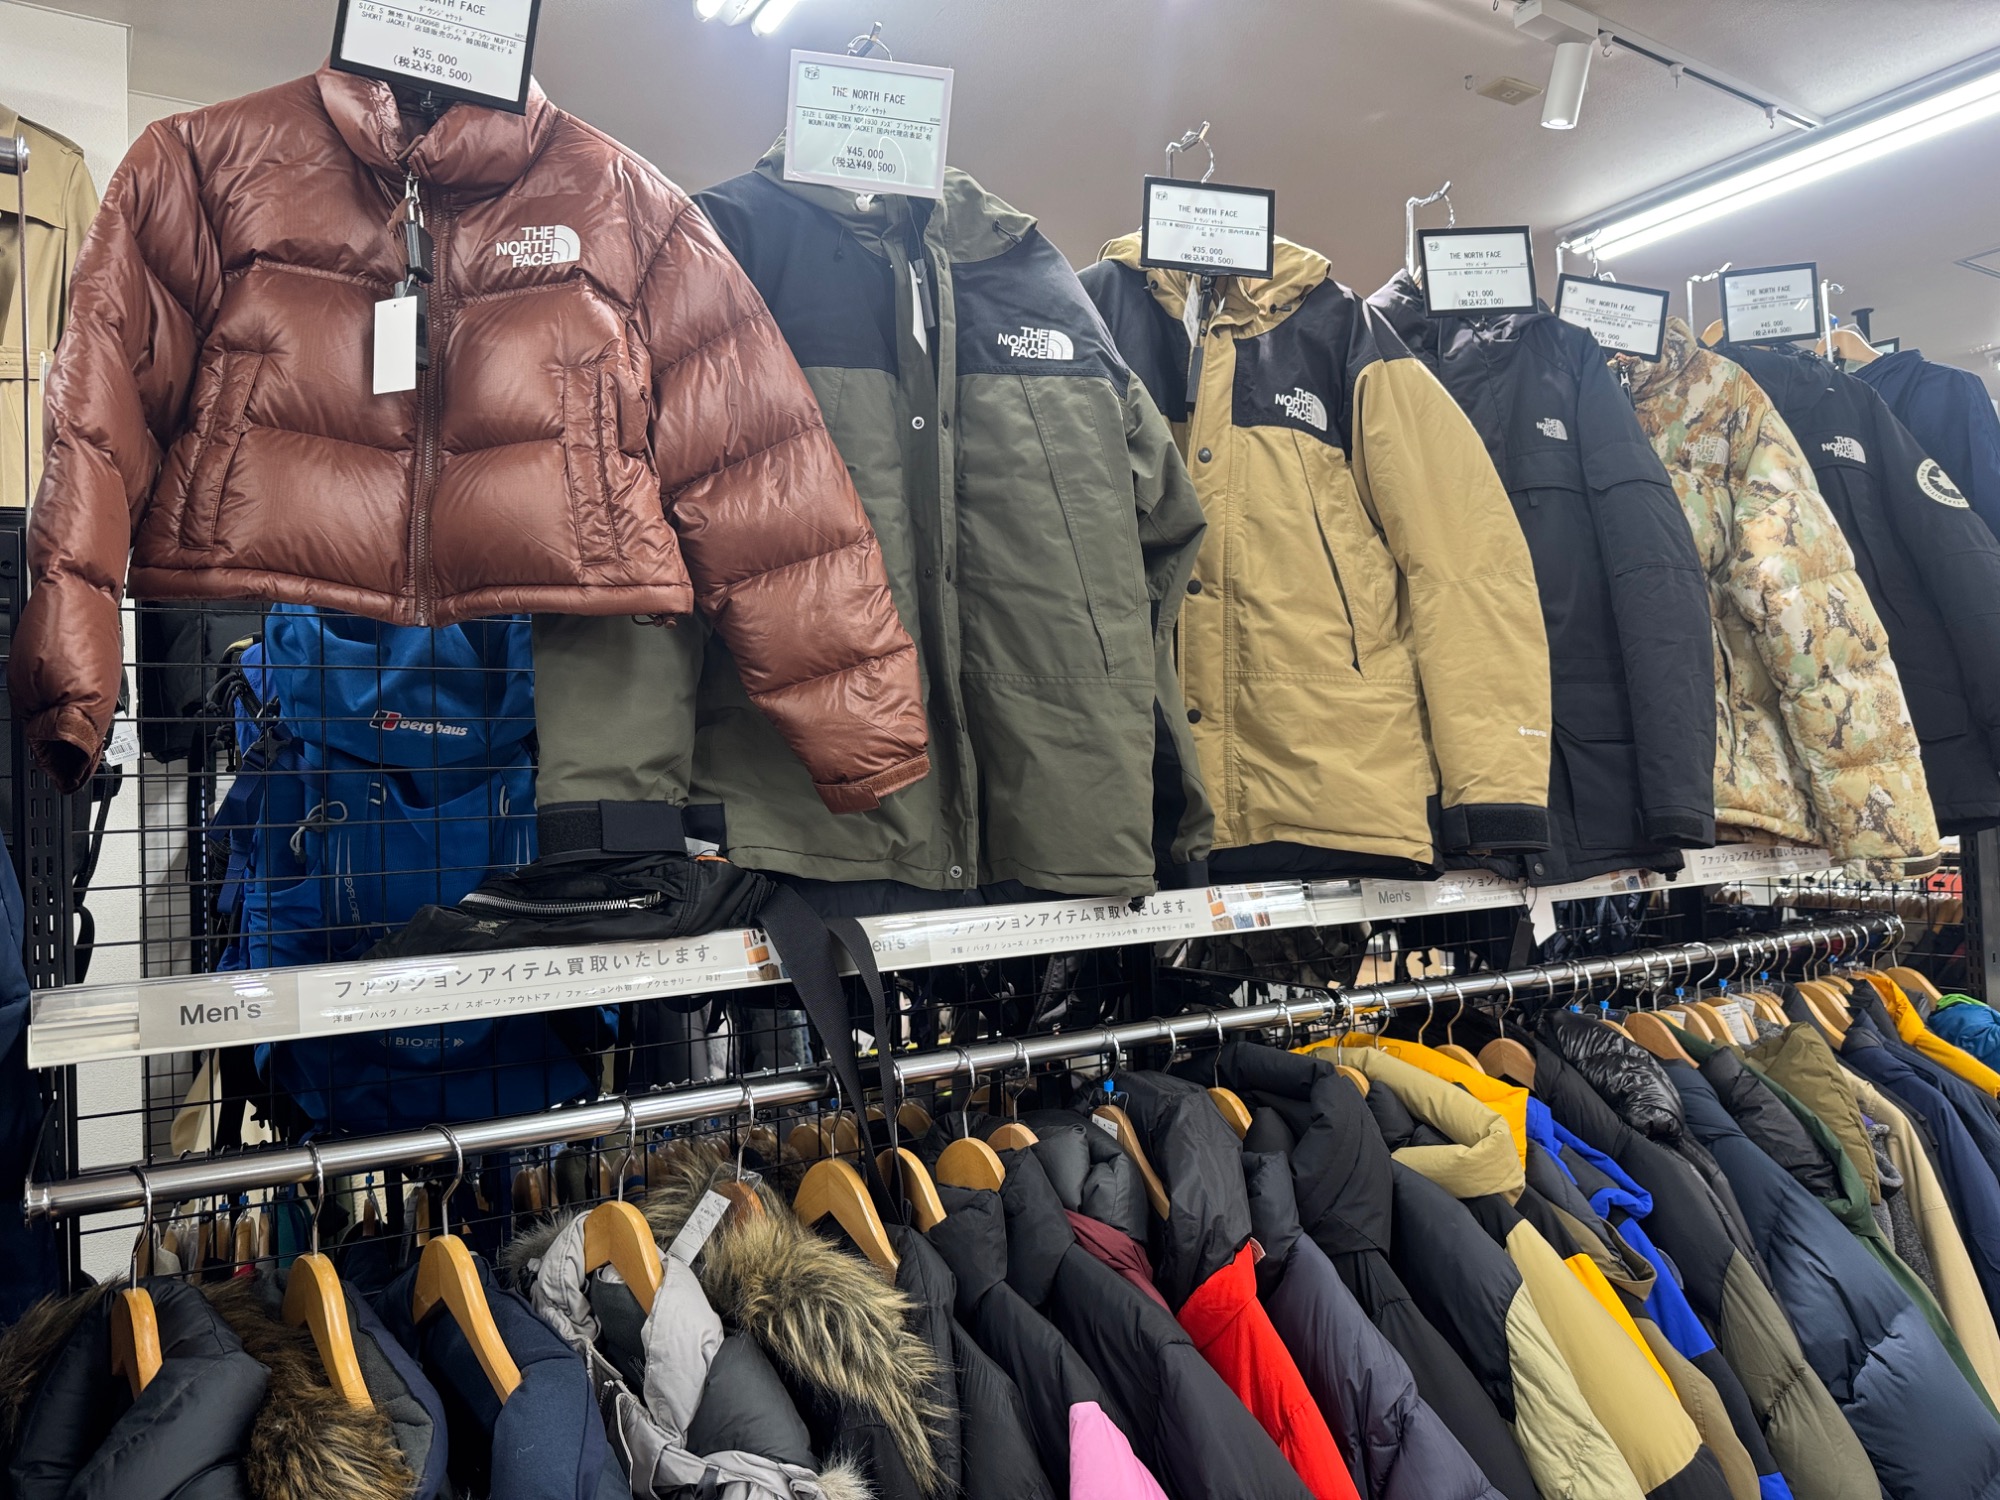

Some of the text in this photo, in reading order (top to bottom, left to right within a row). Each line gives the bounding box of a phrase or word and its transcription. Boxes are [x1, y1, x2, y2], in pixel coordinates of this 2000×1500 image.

[358, 2, 375, 11] SIZE
[460, 0, 486, 15] FACE
[361, 11, 382, 21] SHORT
[386, 18, 410, 28] JACKET
[412, 46, 458, 66] ¥35,000
[393, 54, 472, 83] (税込¥38,500)
[832, 86, 906, 105] THE NORTH FACE
[825, 113, 851, 122] GORE-TEX
[847, 146, 883, 160] ¥45,000
[832, 156, 896, 174] (税込¥49,500)
[1178, 204, 1238, 218] THE NORTH FACE
[521, 225, 554, 240] THE
[495, 239, 553, 256] NORTH
[1192, 246, 1223, 255] ¥35,000
[1464, 251, 1483, 259] NORTH
[1486, 250, 1501, 258] FACE
[512, 252, 552, 268] FACE
[1585, 297, 1595, 305] THE
[1599, 299, 1617, 309] NORTH
[1620, 302, 1636, 312] FACE
[1020, 326, 1049, 339] THE
[997, 333, 1047, 350] NORTH
[1010, 346, 1047, 359] FACE
[1275, 393, 1313, 411] NORTH
[1294, 387, 1313, 403] THE
[1286, 406, 1313, 424] FACE
[1699, 434, 1718, 444] THE
[1834, 436, 1852, 444] THE
[1681, 441, 1716, 455] NORTH
[1821, 442, 1852, 452] NORTH
[1833, 449, 1854, 460] FACE
[1688, 452, 1714, 463] FACE
[400, 717, 467, 736] berghaus
[344, 877, 361, 923] EXPLORE
[1378, 890, 1411, 904] Men's
[872, 935, 906, 952] en's
[334, 944, 719, 999] ファッションアイテム買取いたします。
[370, 1008, 397, 1019] バッグ
[414, 1002, 450, 1014] シューズ
[646, 977, 693, 989] アクセサリー
[180, 1000, 262, 1026] Men's
